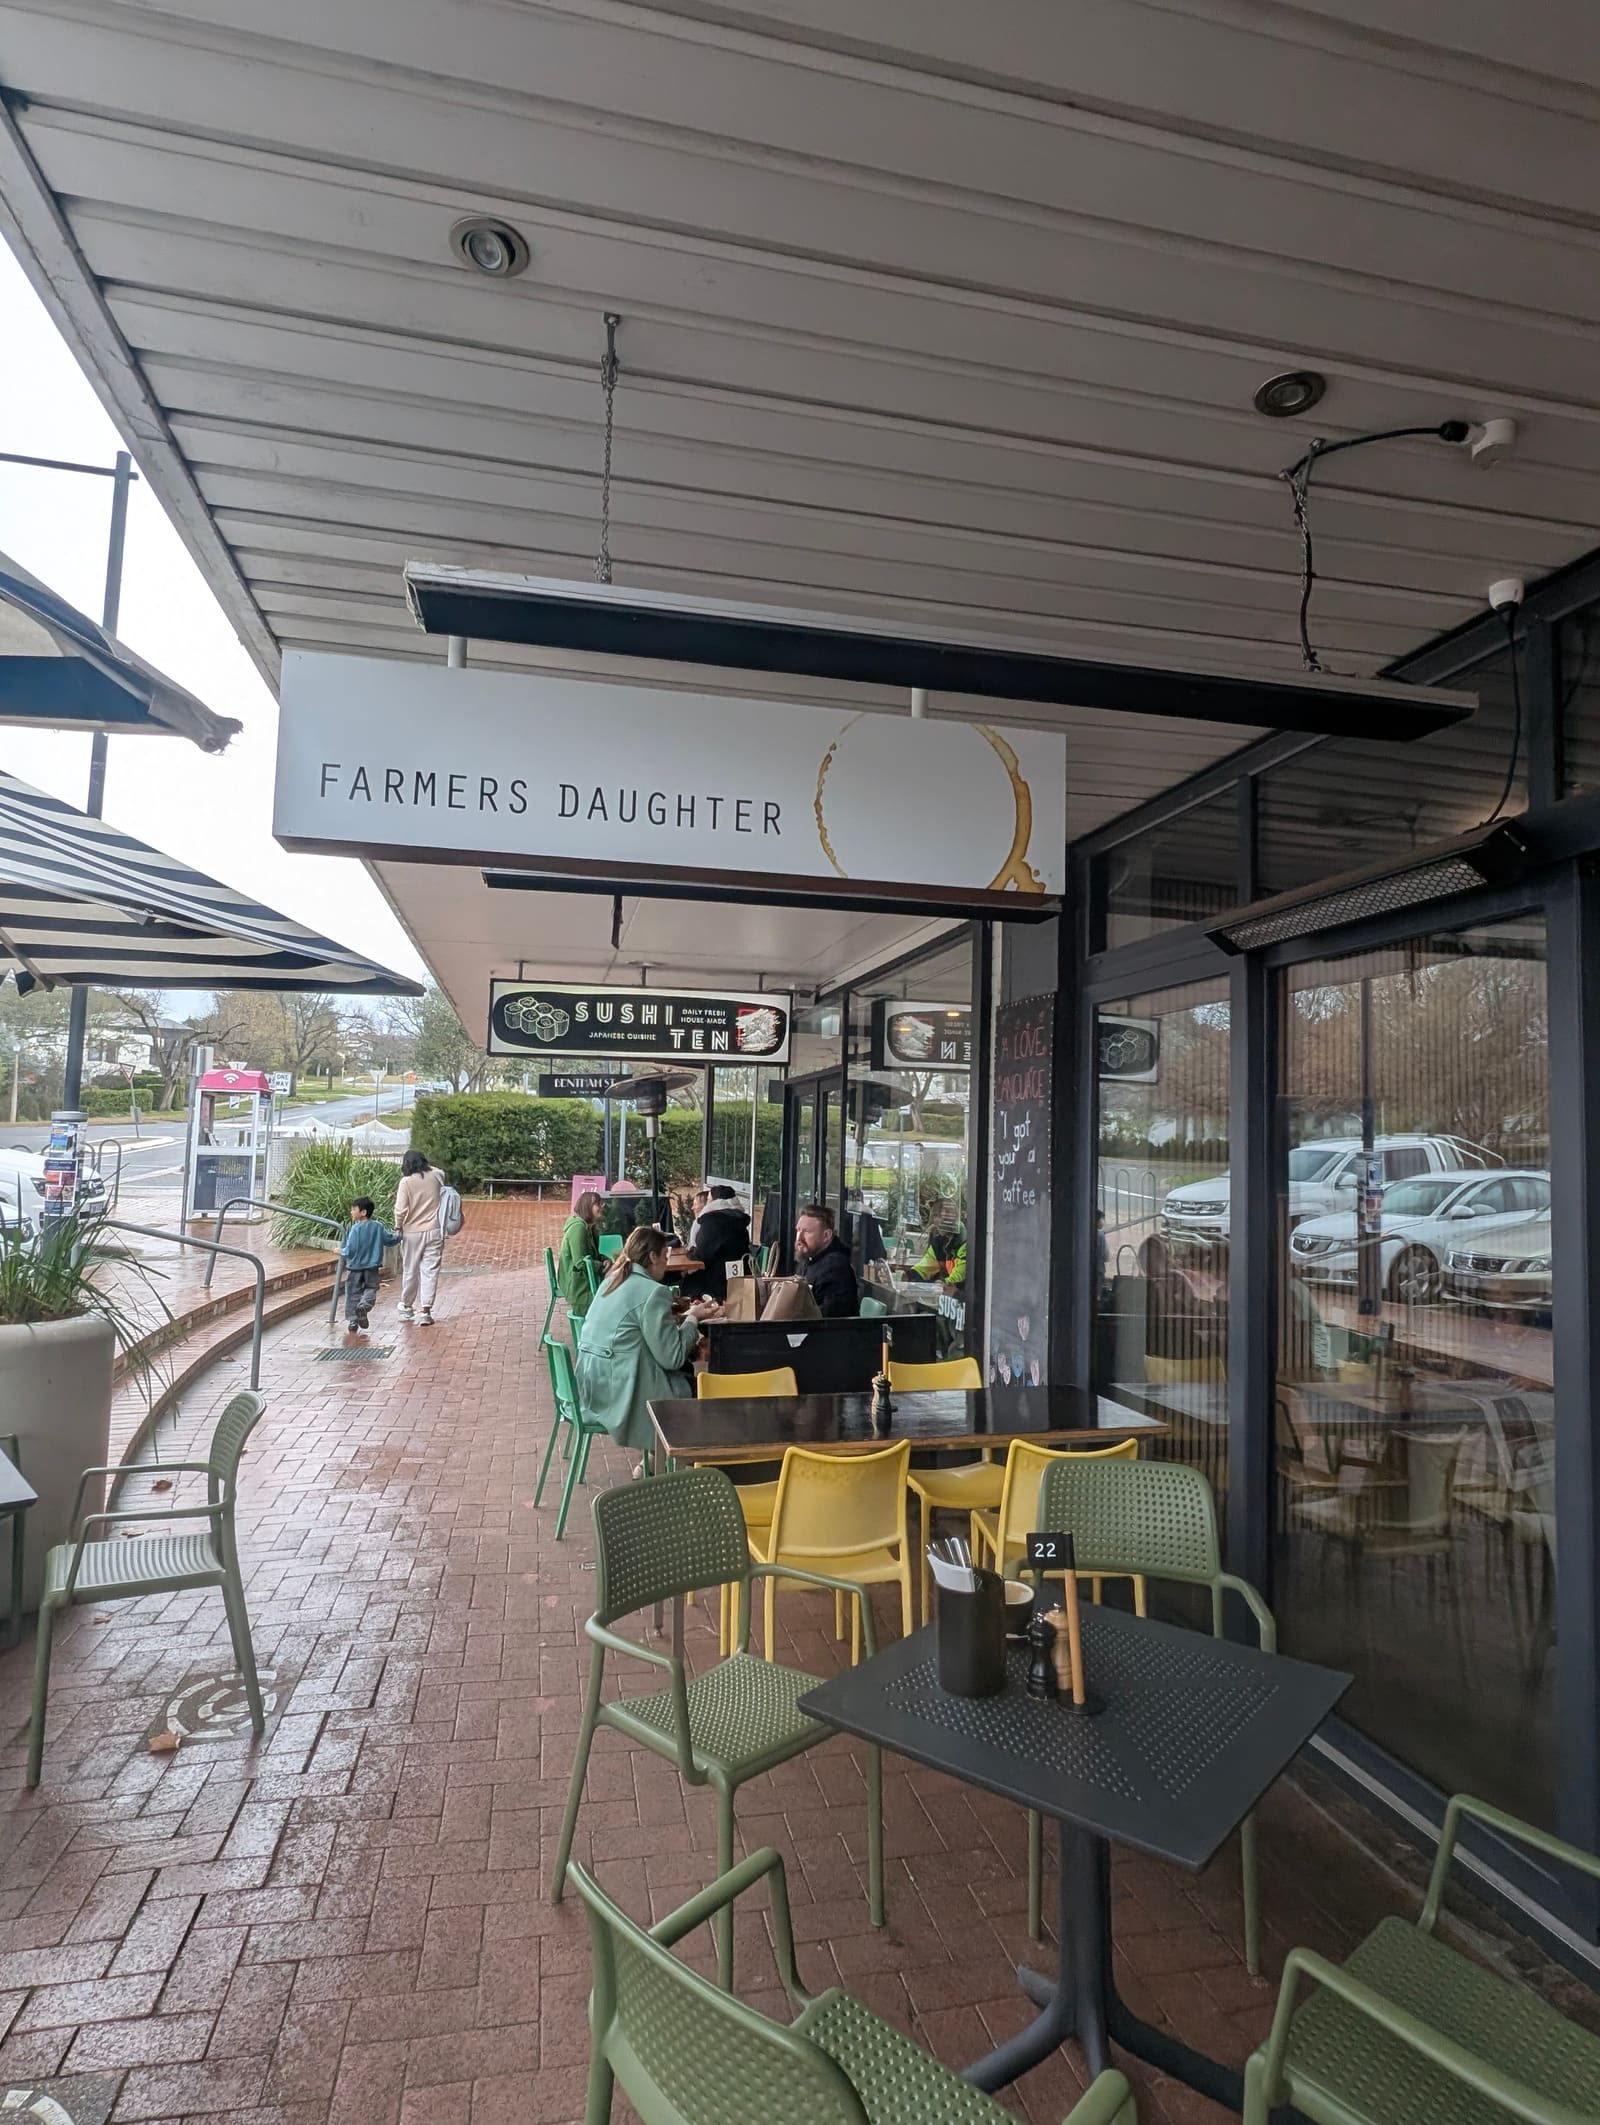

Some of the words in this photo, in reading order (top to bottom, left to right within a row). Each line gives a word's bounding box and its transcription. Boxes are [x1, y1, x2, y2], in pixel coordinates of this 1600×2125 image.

[320, 762, 528, 814] FARMERS
[558, 784, 782, 836] DAUGHTER
[575, 1001, 673, 1026] SUSHI
[682, 1008, 703, 1016] DAILY
[704, 1009, 726, 1018] FRESH
[588, 1031, 625, 1040] JAPANESE
[626, 1032, 657, 1041] CUISINE
[670, 1028, 729, 1051] TEN
[1015, 1026, 1045, 1060] LOVE
[1012, 1109, 1031, 1152] got
[998, 1151, 1016, 1182] you
[1027, 1147, 1036, 1163] a
[732, 1264, 739, 1276] 3
[1034, 1543, 1057, 1558] 22
